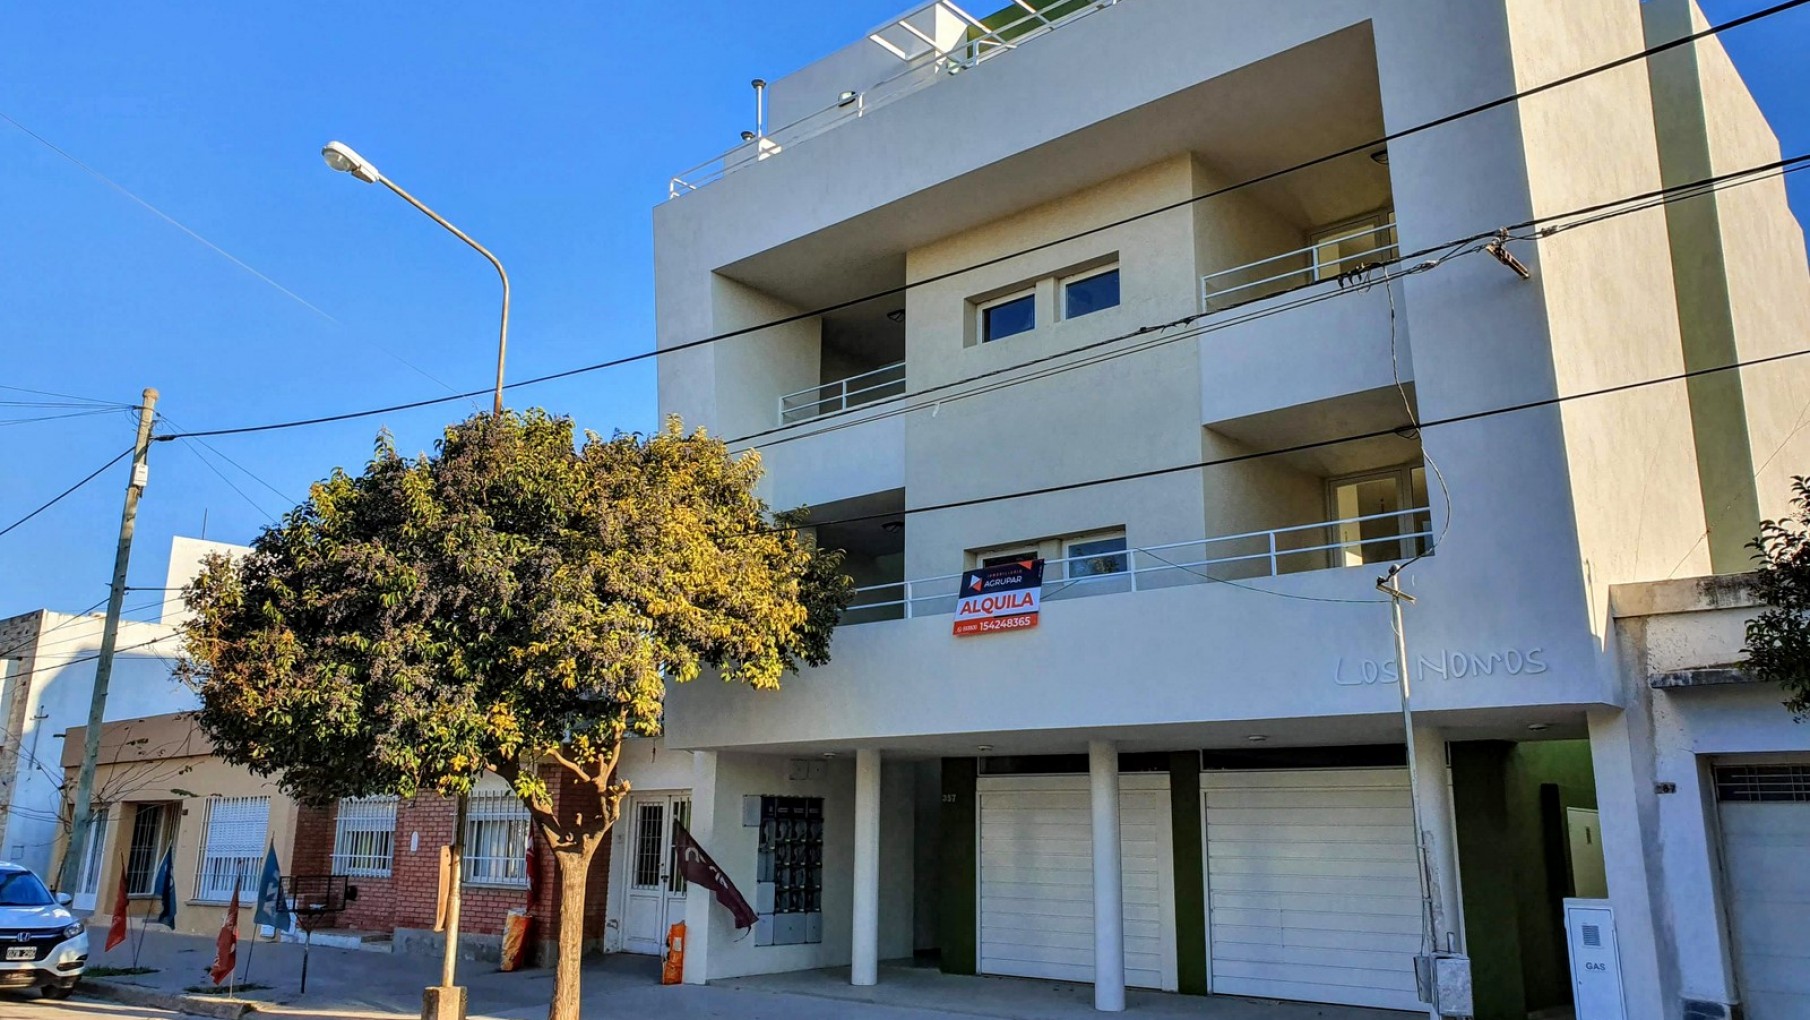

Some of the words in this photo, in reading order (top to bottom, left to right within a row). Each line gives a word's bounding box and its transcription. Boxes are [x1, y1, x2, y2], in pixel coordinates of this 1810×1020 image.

[984, 575, 1022, 588] AGRUPAR
[960, 592, 1033, 615] ALQUILA
[980, 616, 1030, 631] 154248365
[1335, 655, 1399, 686] LOS
[1585, 962, 1606, 971] GAS
